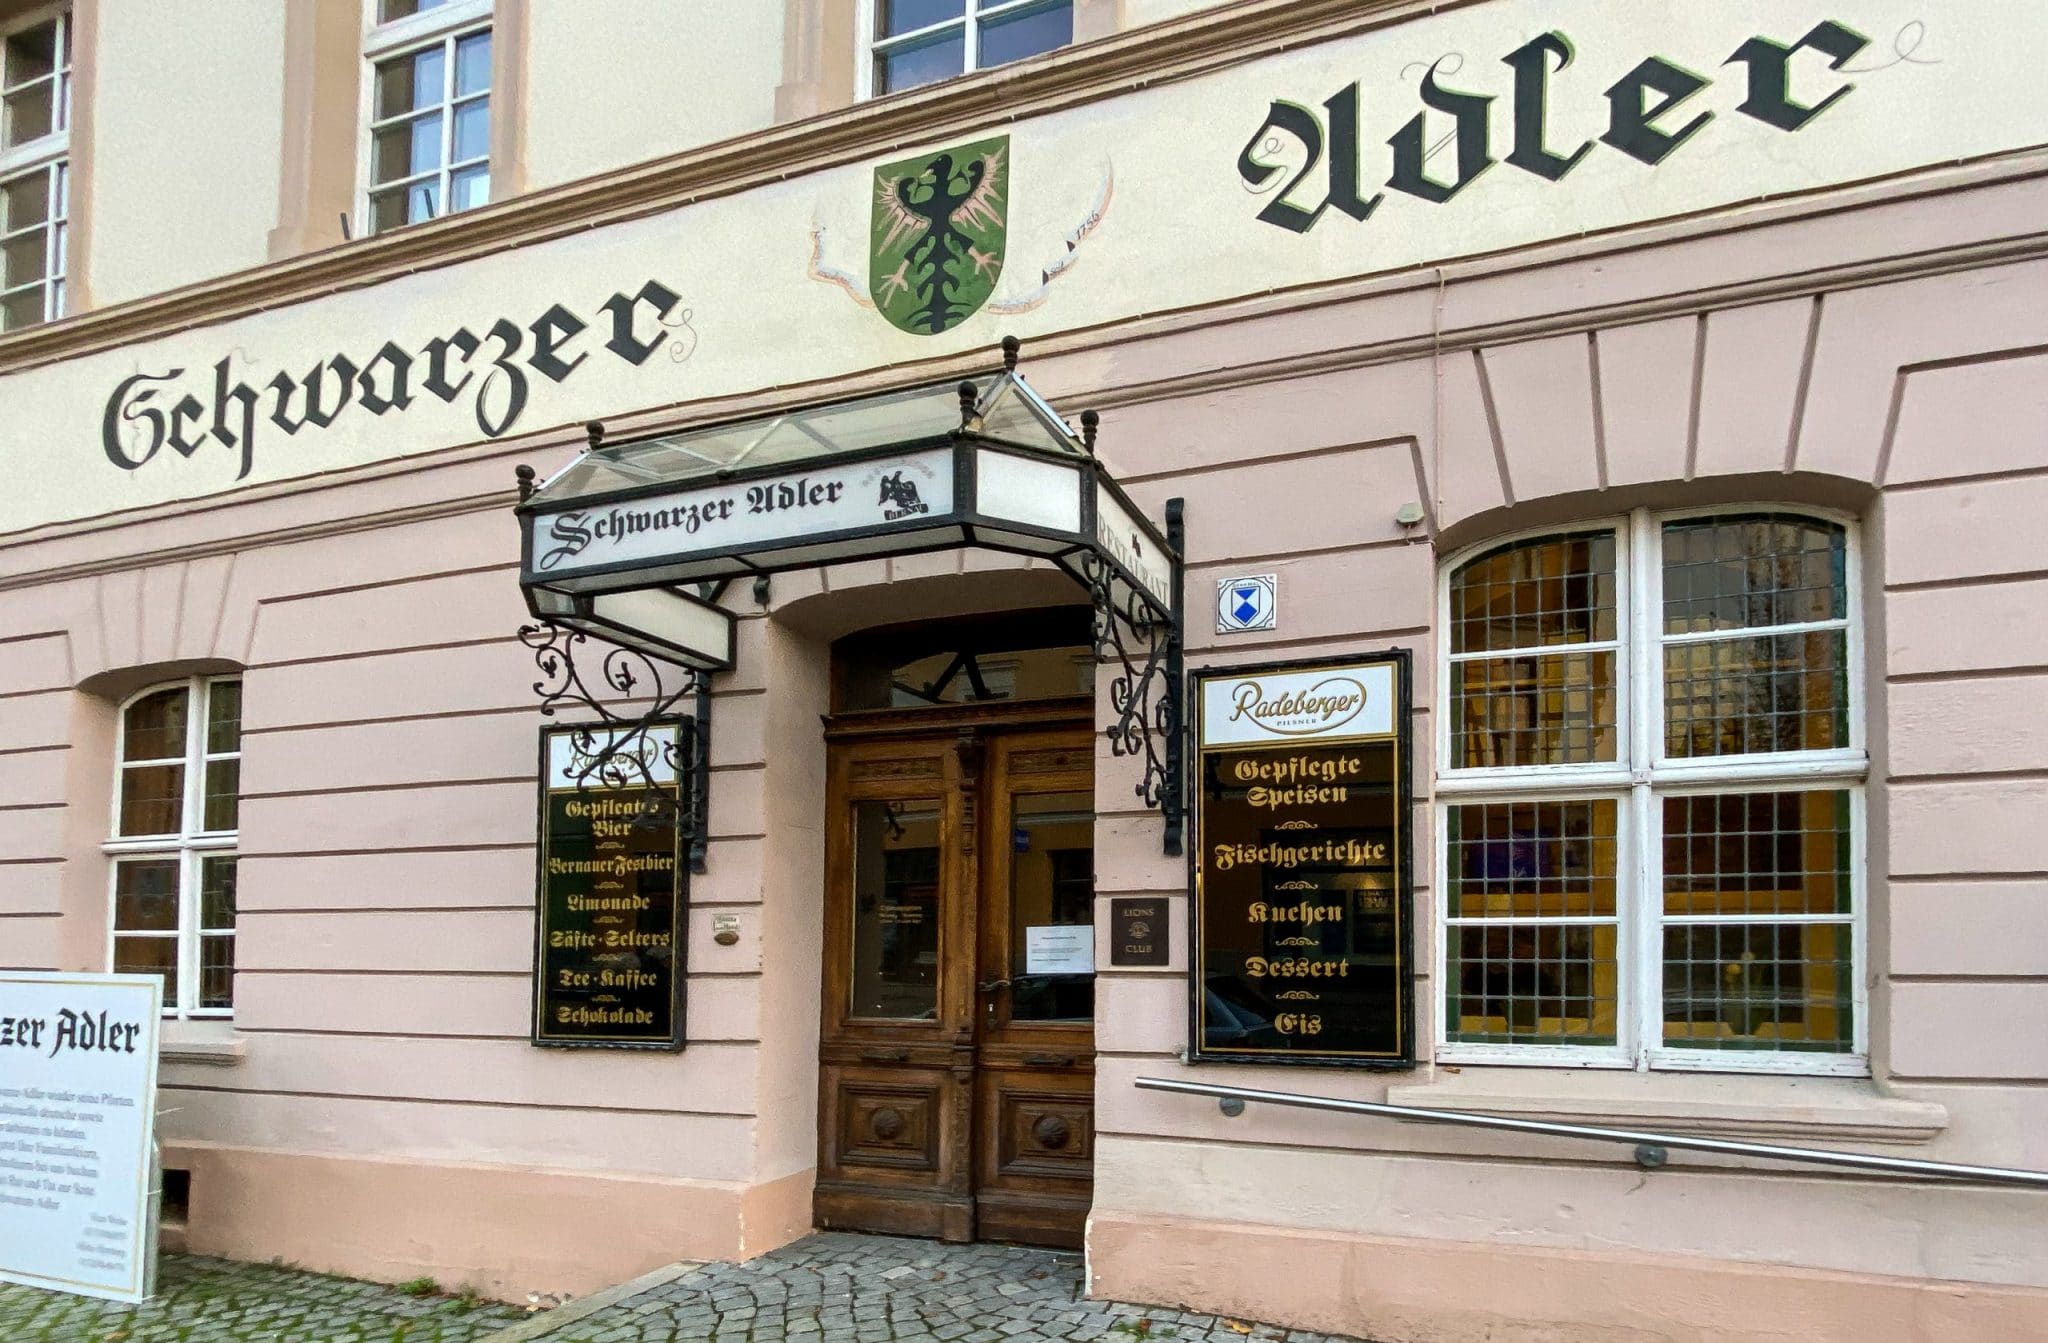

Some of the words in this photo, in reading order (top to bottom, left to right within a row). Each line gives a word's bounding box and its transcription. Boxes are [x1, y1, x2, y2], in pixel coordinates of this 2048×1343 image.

[101, 279, 690, 482] Schwarzer
[1237, 19, 1880, 235] Adler
[540, 497, 734, 570] Schwarzer
[746, 478, 844, 515] Adler
[1229, 678, 1362, 724] Radeberger
[1233, 754, 1361, 785] Gepflegte
[1246, 784, 1348, 811] Speisen
[591, 819, 633, 838] Bier
[1213, 837, 1387, 871] Fischgerichte
[567, 894, 651, 911] Limonade
[1121, 906, 1156, 917] LIONS
[1247, 900, 1343, 928] Kuchen
[550, 930, 597, 951] Säfte
[604, 929, 670, 948] Selters
[1125, 944, 1153, 954] CLUB
[1244, 955, 1350, 979] Dessert
[559, 968, 591, 986] Tee
[600, 968, 657, 991] Kaffee
[557, 1006, 655, 1027] Schokolade
[1272, 1012, 1323, 1036] Eis
[48, 1007, 141, 1059] Adler
